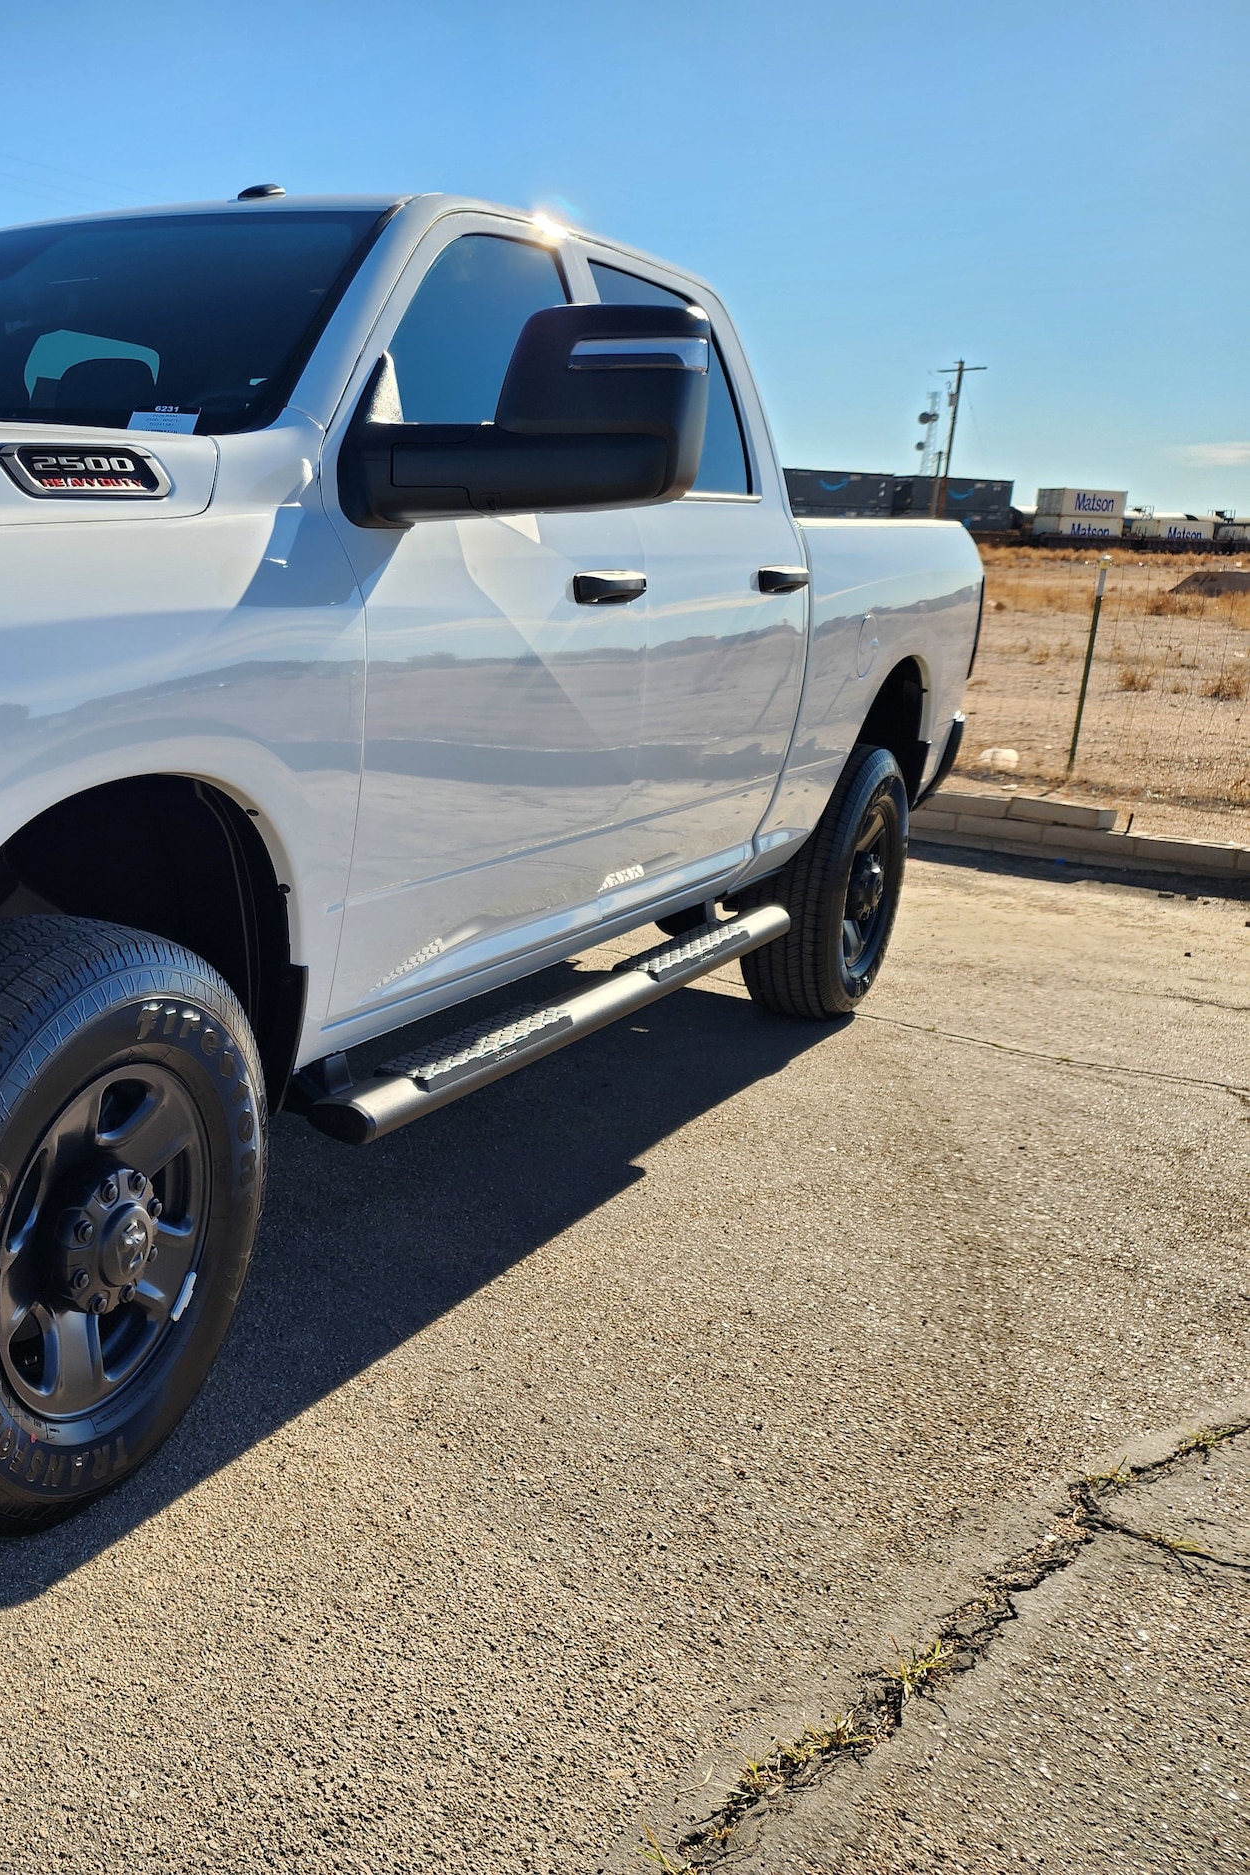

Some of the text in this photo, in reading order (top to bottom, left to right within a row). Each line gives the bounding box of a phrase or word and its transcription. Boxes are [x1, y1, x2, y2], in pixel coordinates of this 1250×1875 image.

[154, 405, 180, 413] 6231
[31, 456, 136, 472] 2500
[40, 477, 142, 487] HEAVY DUTY
[1074, 493, 1115, 513] Matson
[1070, 522, 1110, 537] Matson
[1167, 526, 1202, 540] Matson
